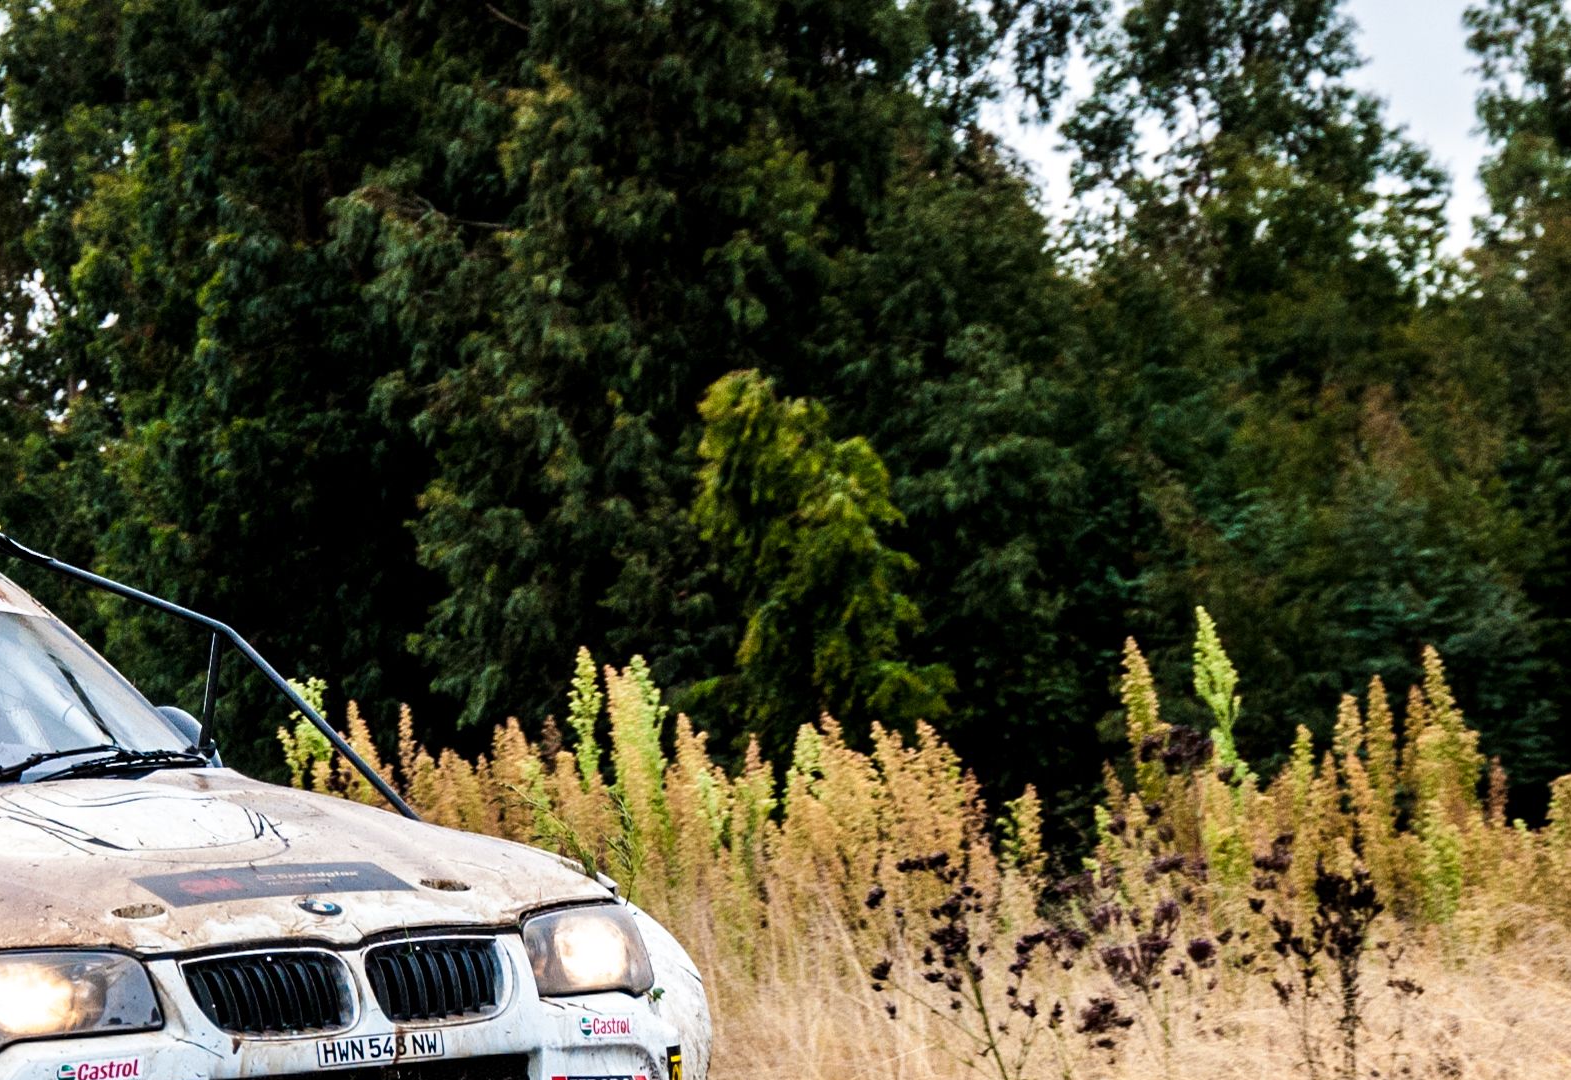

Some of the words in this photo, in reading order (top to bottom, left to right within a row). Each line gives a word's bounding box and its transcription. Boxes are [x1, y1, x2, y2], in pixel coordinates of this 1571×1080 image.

[592, 1018, 632, 1035] Castrol
[322, 1039, 365, 1064] HWN
[368, 1035, 408, 1059] 548
[411, 1032, 438, 1056] NW
